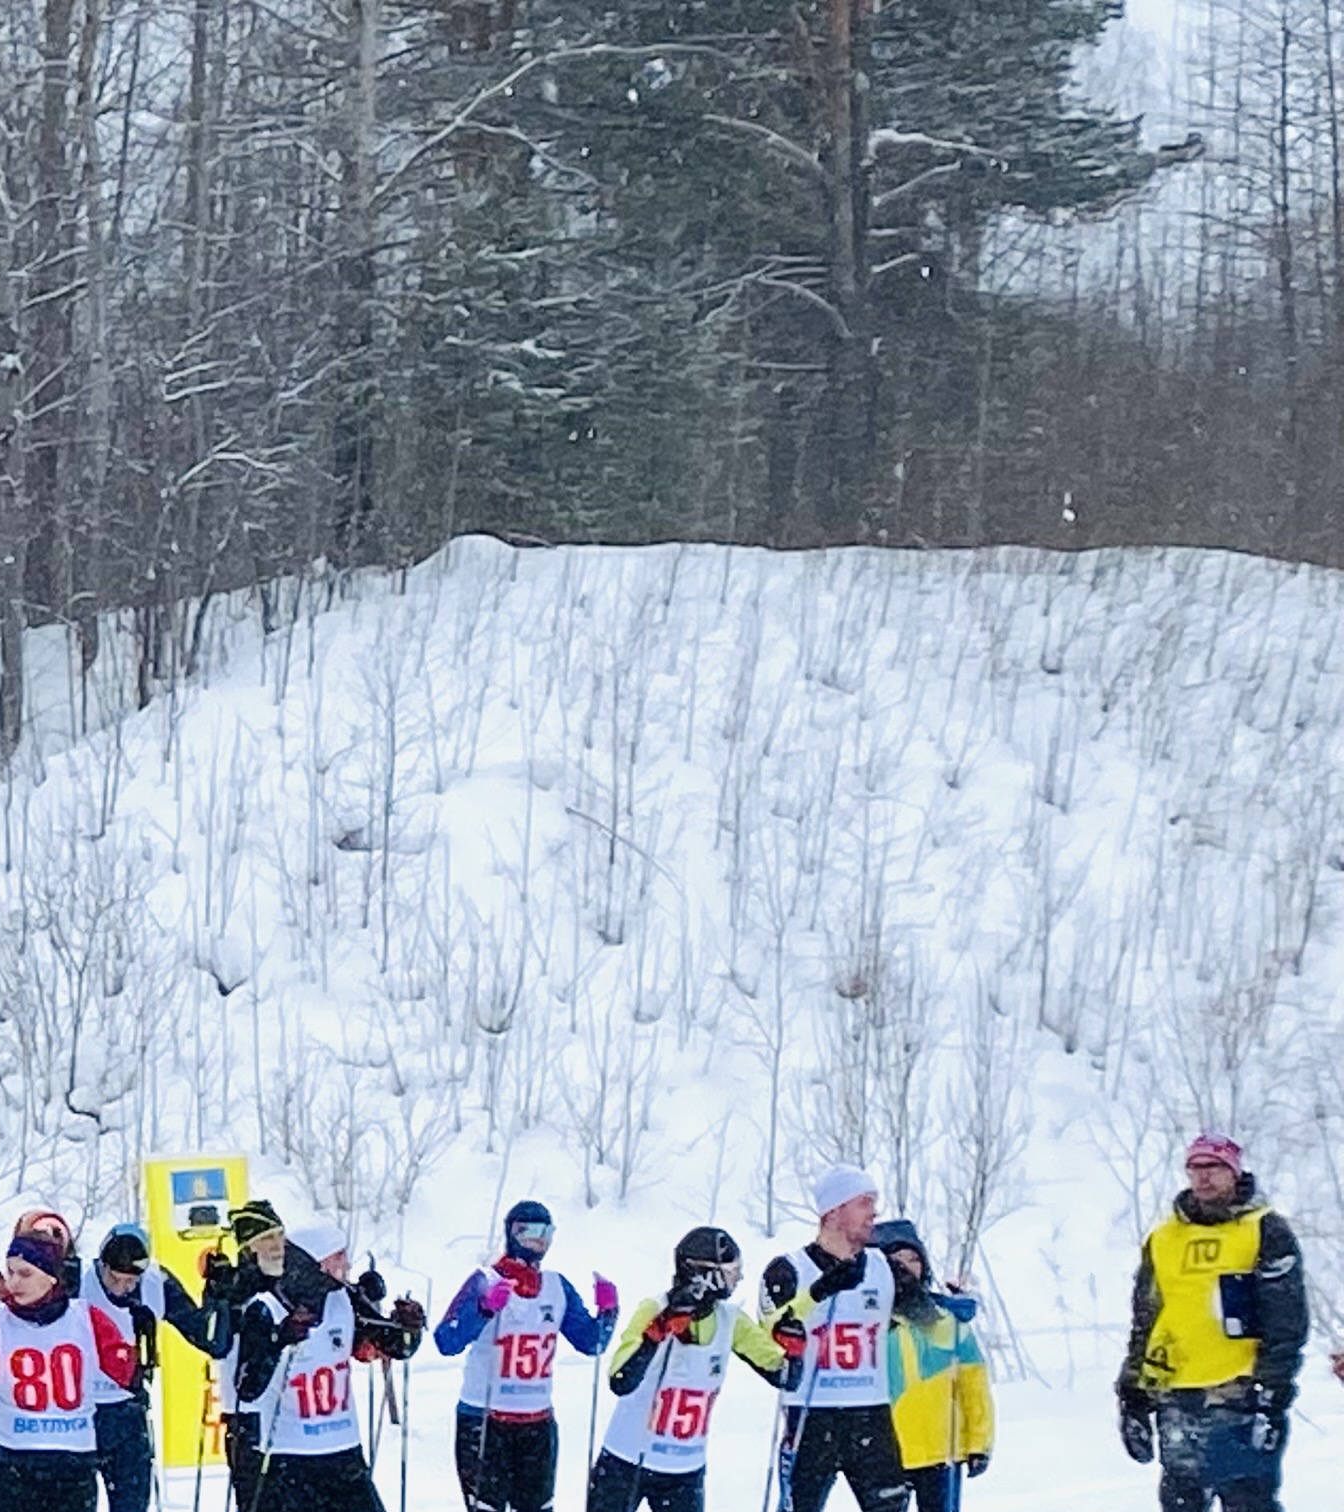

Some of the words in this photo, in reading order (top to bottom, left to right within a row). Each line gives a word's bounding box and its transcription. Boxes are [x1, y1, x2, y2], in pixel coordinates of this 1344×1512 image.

[10, 1343, 82, 1411] 80
[494, 1332, 557, 1380] 152
[289, 1361, 350, 1418] 107
